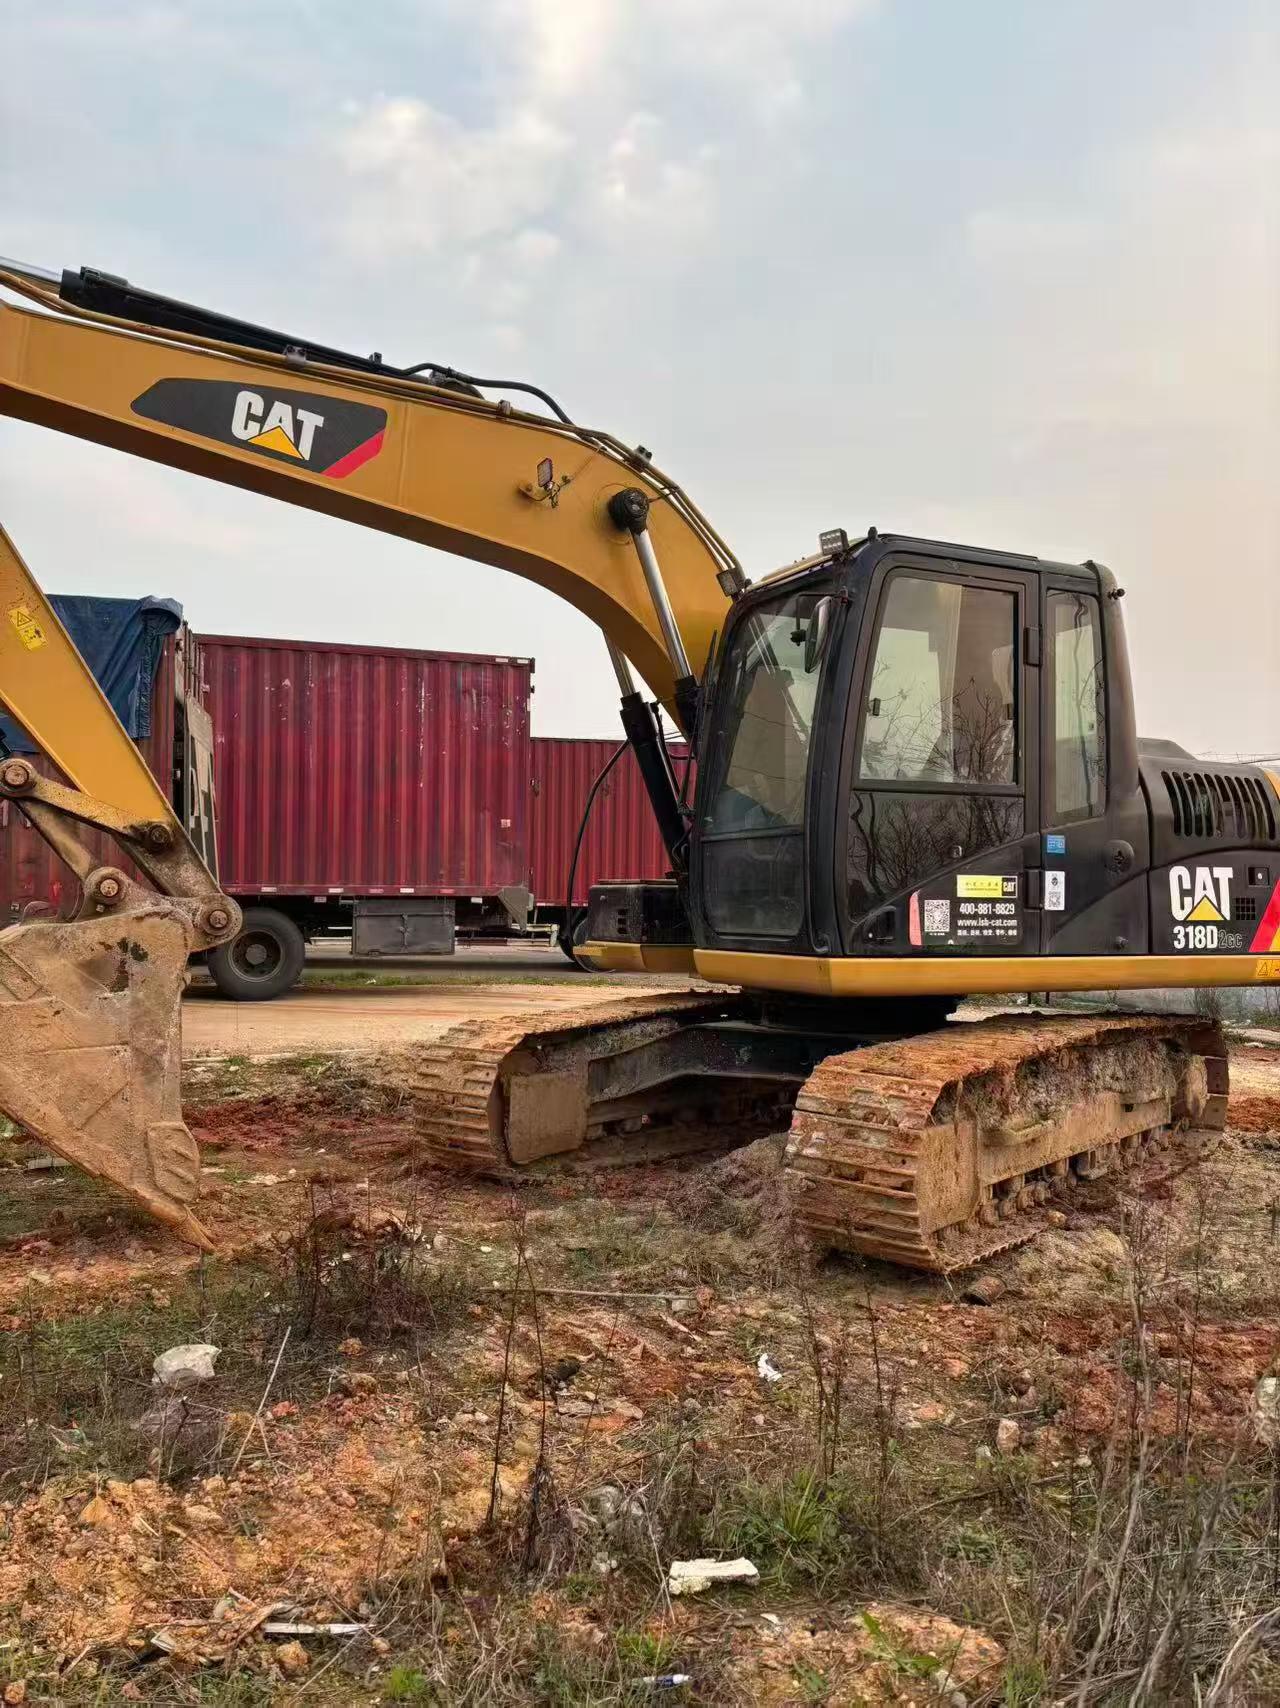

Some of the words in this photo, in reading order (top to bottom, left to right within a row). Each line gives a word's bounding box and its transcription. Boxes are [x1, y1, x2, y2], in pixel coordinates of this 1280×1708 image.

[231, 390, 325, 461] CAT
[1002, 881, 1015, 892] CAT
[1169, 865, 1233, 921] CAT
[960, 903, 1015, 914] 400-881-8829
